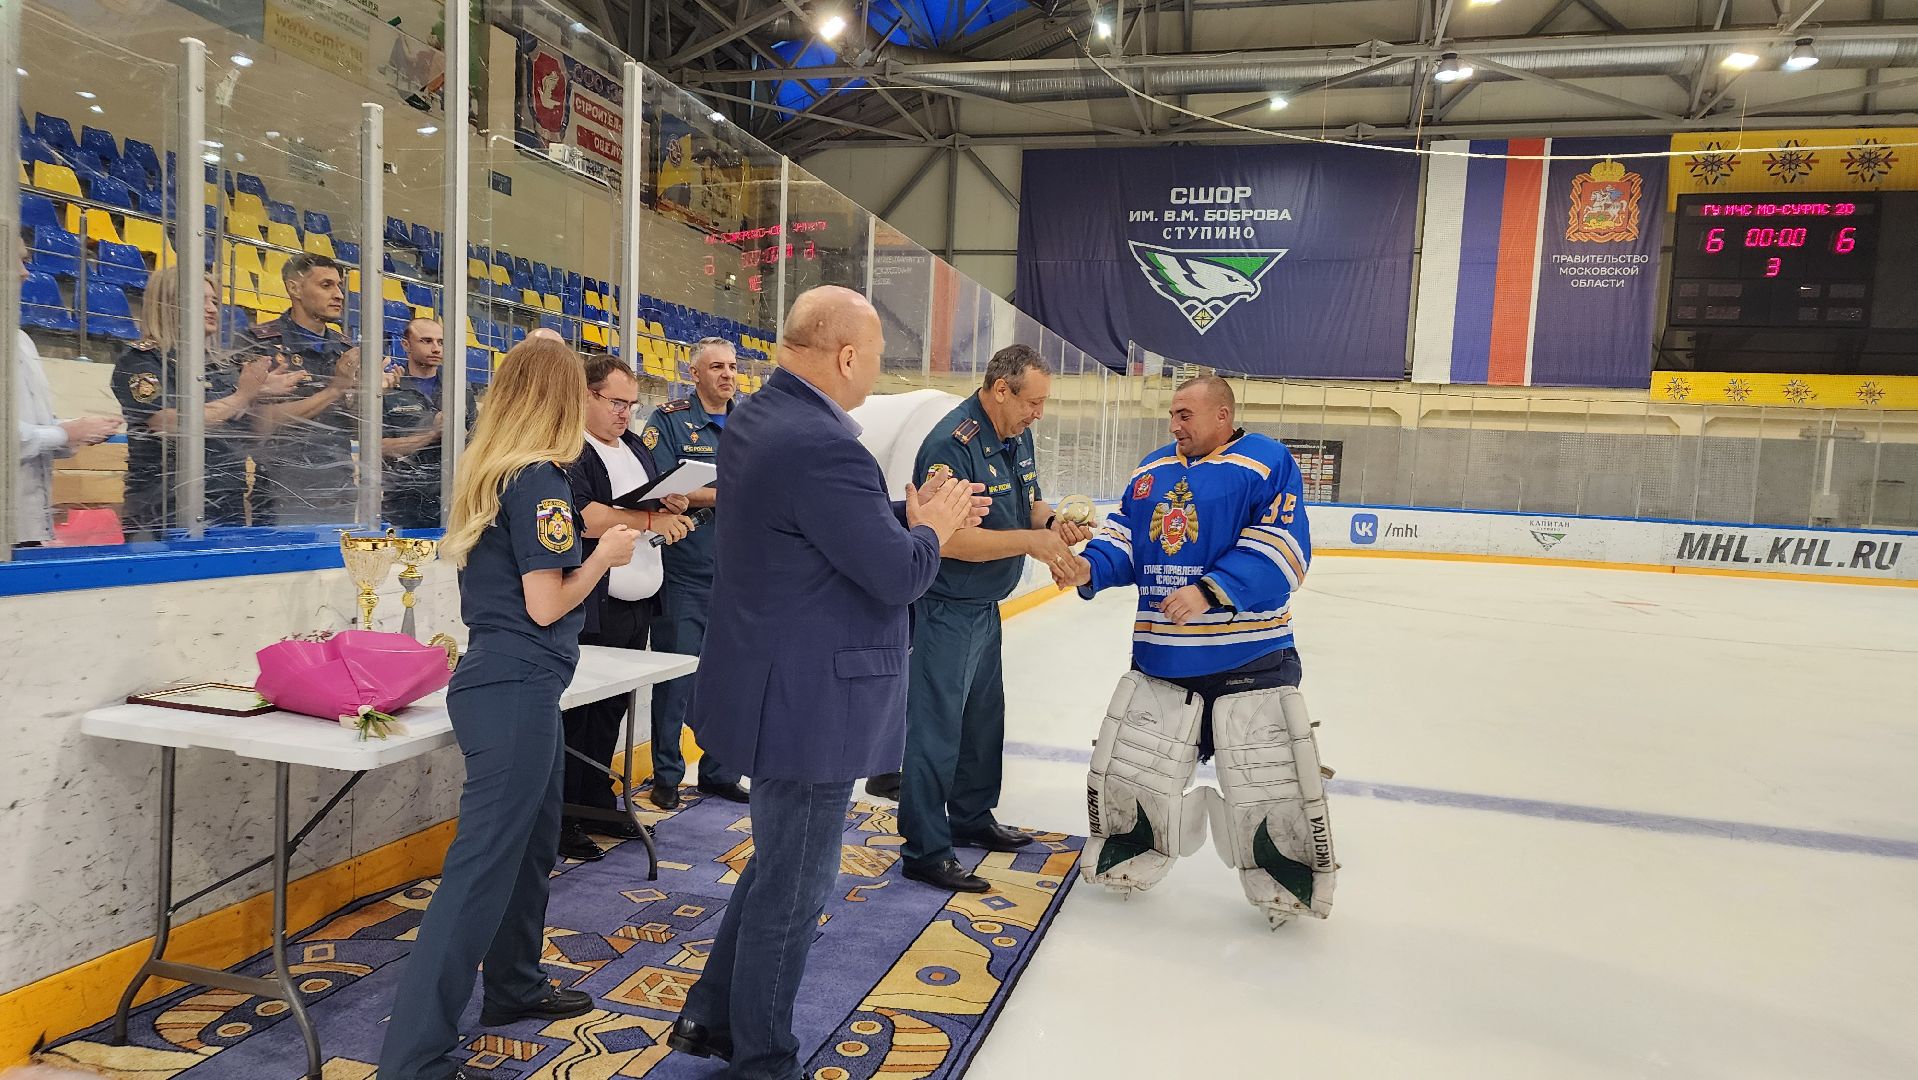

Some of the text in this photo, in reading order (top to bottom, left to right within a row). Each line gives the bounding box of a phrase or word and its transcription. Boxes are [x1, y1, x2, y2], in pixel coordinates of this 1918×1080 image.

[1170, 186, 1252, 205] СШОР
[1128, 208, 1293, 223] ИМ. В.М. БОБРОВА
[1162, 226, 1256, 240] СТУПИНО
[1705, 227, 1857, 253] 6 00:00 6
[1552, 254, 1649, 263] ПРАВИТЕЛЬСТВО
[1764, 257, 1782, 277] 3
[1559, 265, 1639, 276] МОСКОВСКОЙ
[1570, 279, 1625, 288] ОБЛАСТИ
[1384, 522, 1418, 539] /mhl
[1529, 520, 1570, 528] КАПИТАН
[1676, 532, 1903, 571] MHL.KHL.RU
[1088, 785, 1103, 835] VAUGHN
[1310, 814, 1331, 868] VAUGHN
